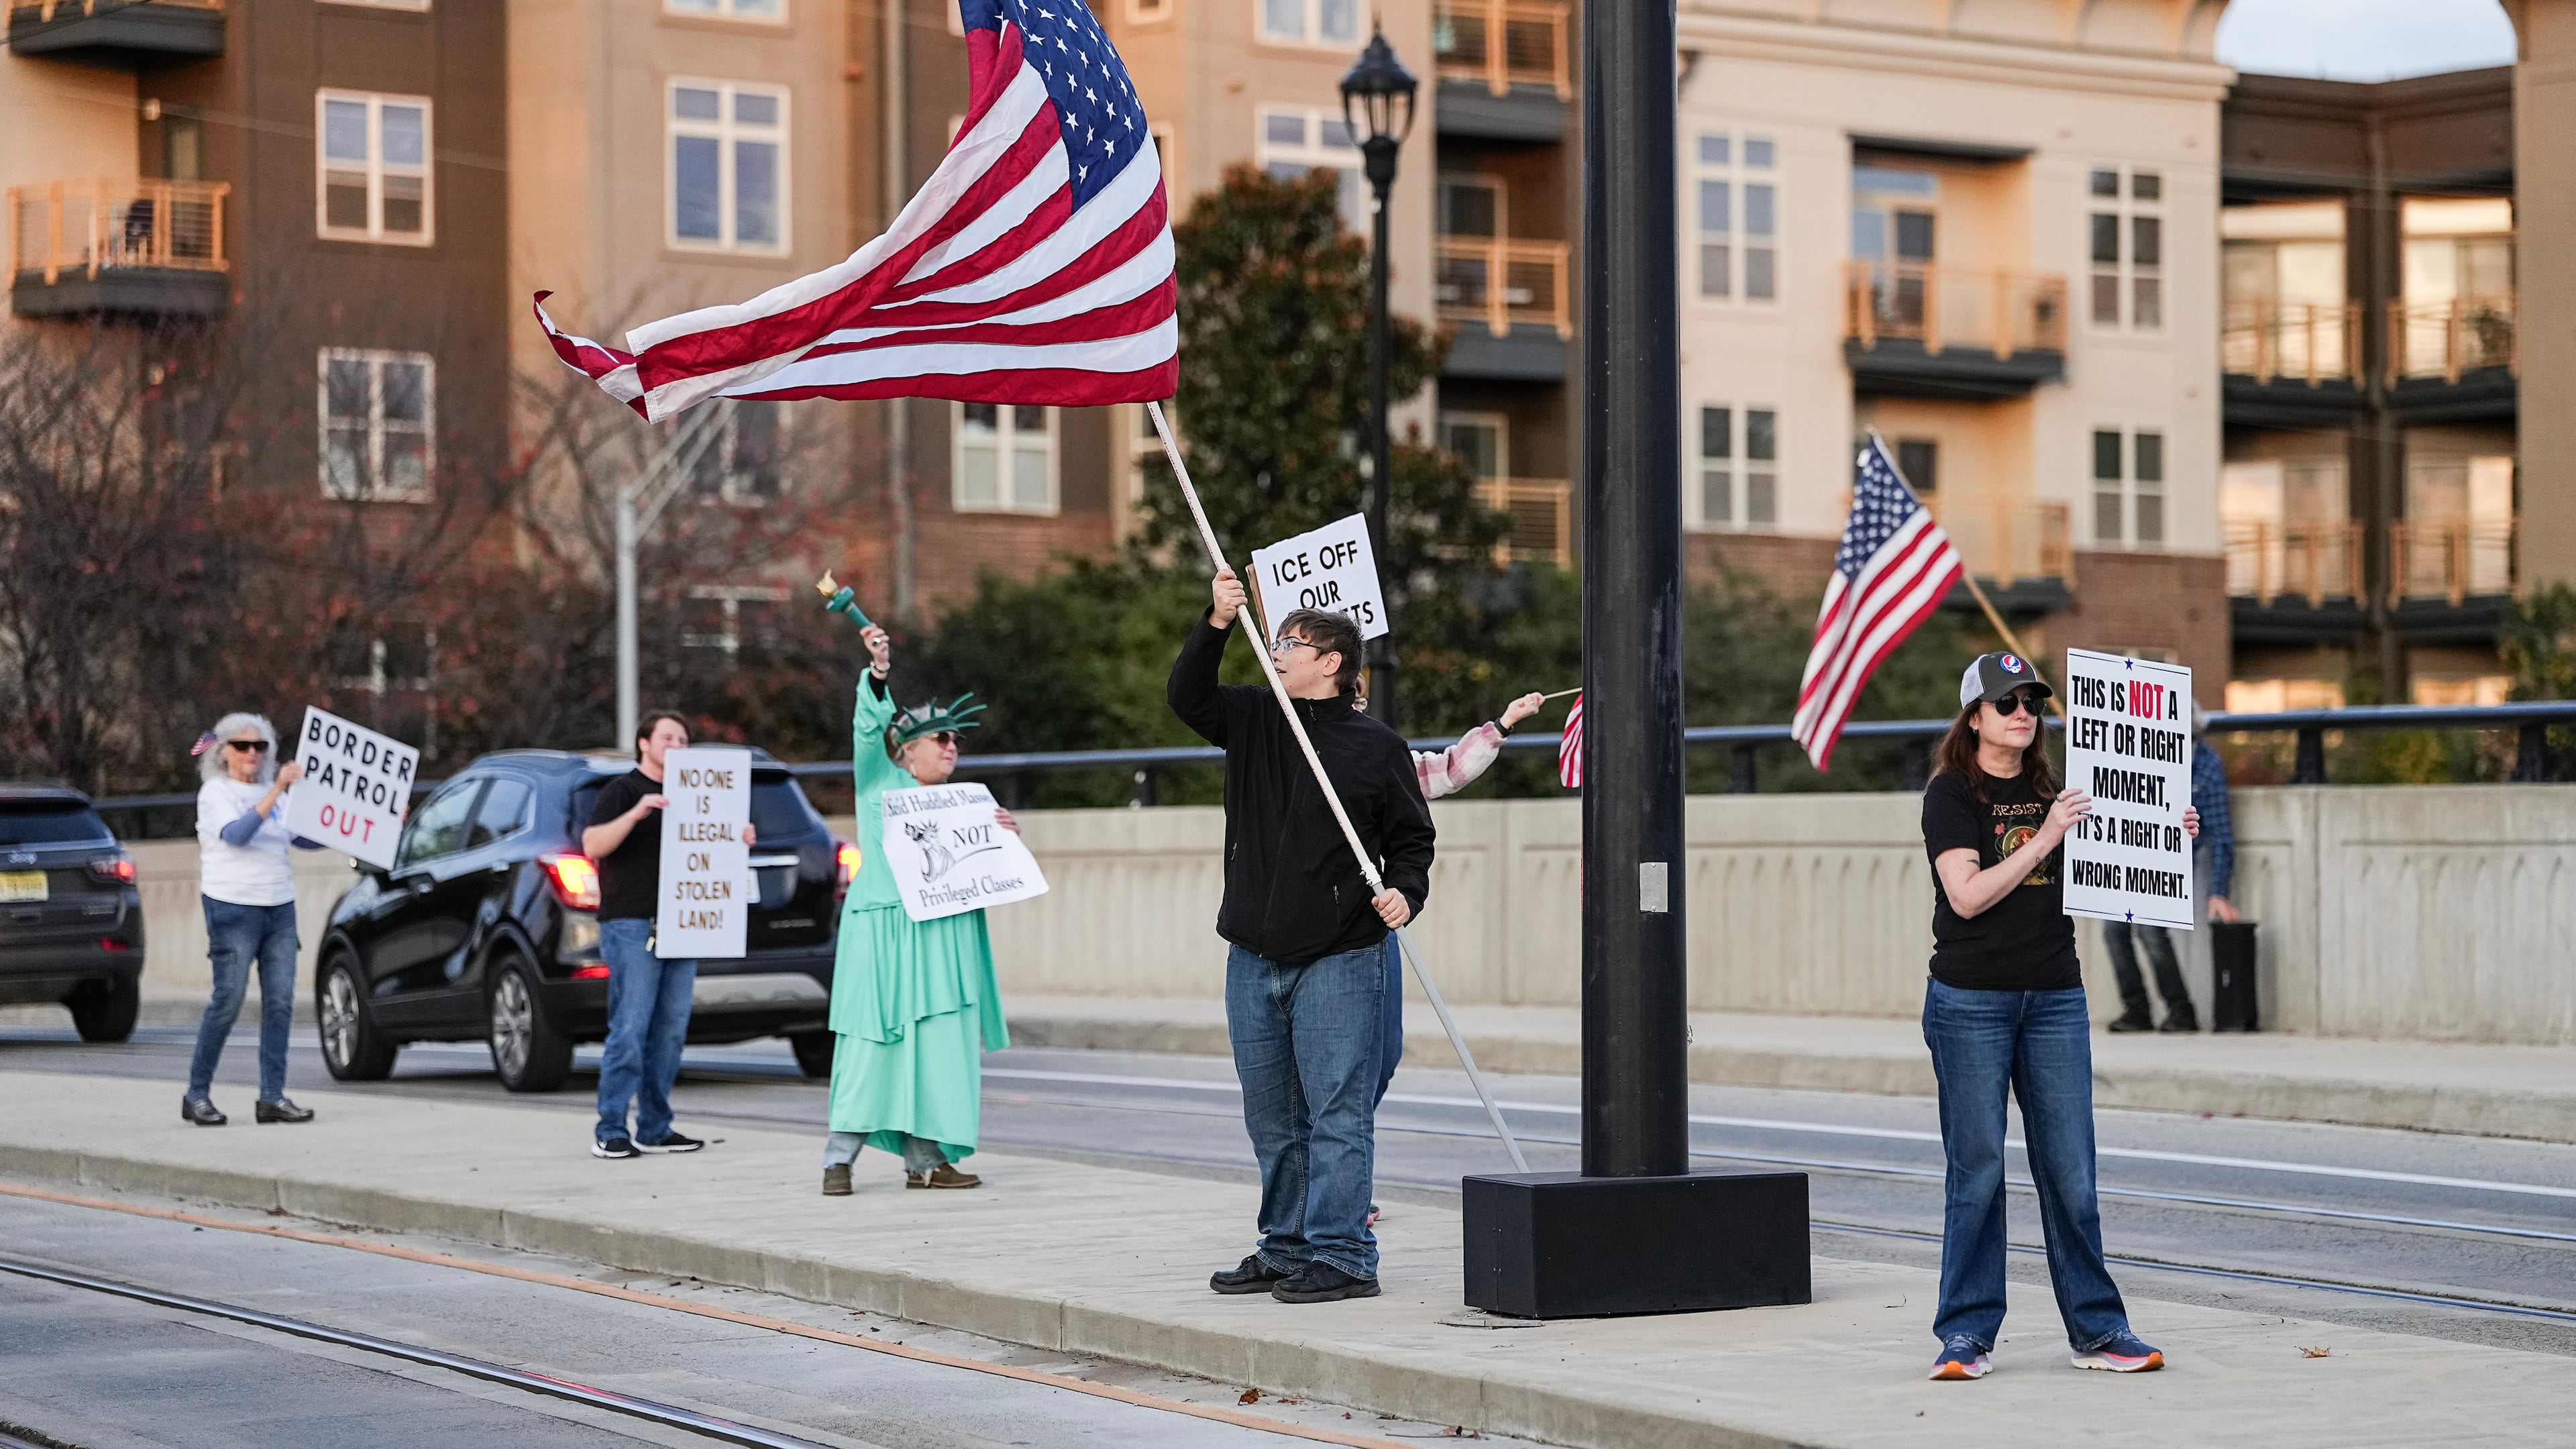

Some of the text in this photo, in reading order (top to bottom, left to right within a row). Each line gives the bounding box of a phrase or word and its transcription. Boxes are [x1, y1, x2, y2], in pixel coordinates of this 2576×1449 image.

[1272, 540, 1358, 586] ICE OFF
[1300, 580, 1342, 608] OUR
[2072, 675, 2178, 721] THIS IS NOT A
[309, 717, 412, 783] BORDER
[2072, 716, 2185, 765] LEFT OR RIGHT
[305, 756, 398, 814] PATROL
[679, 769, 734, 790] NO ONE
[2093, 765, 2170, 812] MOMENT,
[696, 796, 710, 814] IS
[887, 795, 909, 817] Said
[908, 791, 957, 812] Huddled
[1992, 803, 2044, 816] RESIST
[320, 805, 375, 843] OUT
[678, 822, 735, 842] ILLEGAL
[952, 824, 993, 849] NOT
[2077, 812, 2182, 853] IT'S A RIGHT OR
[687, 853, 710, 872] ON
[676, 881, 732, 900] STOLEN
[918, 875, 1025, 906] Privileged Classes
[2072, 859, 2188, 900] WRONG MOMENT.
[678, 910, 724, 930] LAND!
